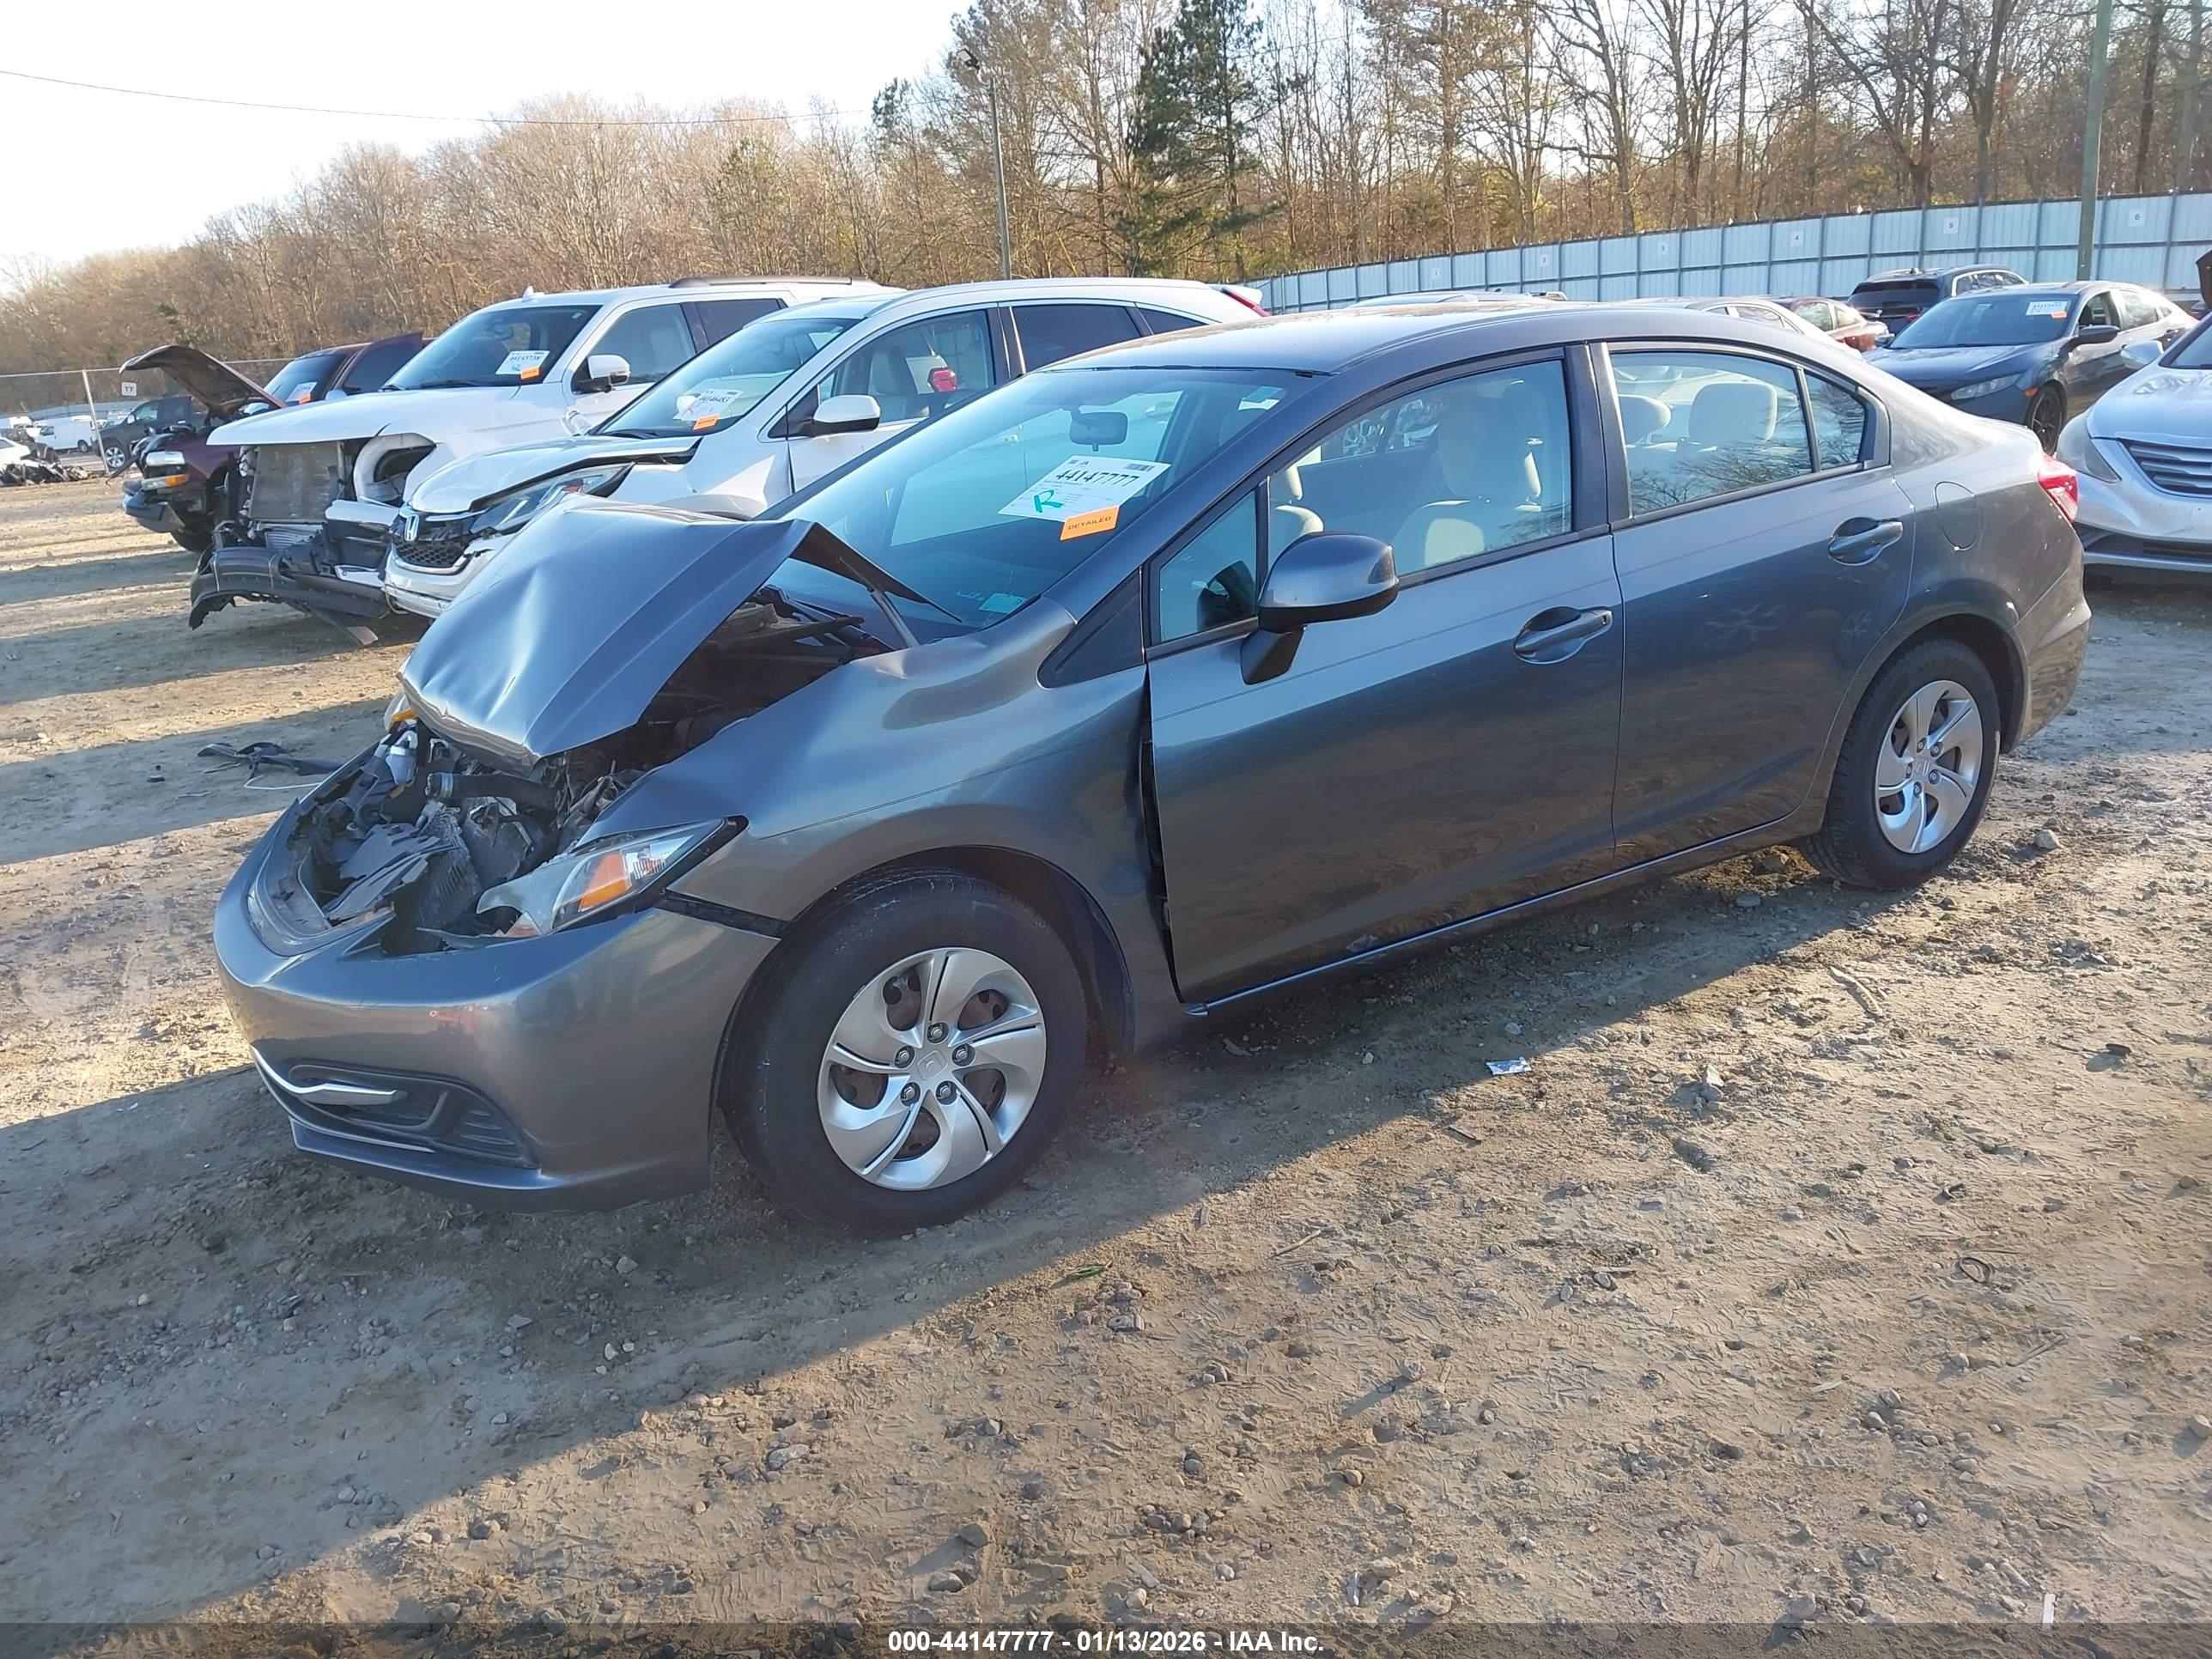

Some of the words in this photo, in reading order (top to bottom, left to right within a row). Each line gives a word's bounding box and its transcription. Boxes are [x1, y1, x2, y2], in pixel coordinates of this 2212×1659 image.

[1056, 468, 1141, 487] 44147777
[1034, 489, 1064, 514] R
[1067, 516, 1112, 530] DETAILED
